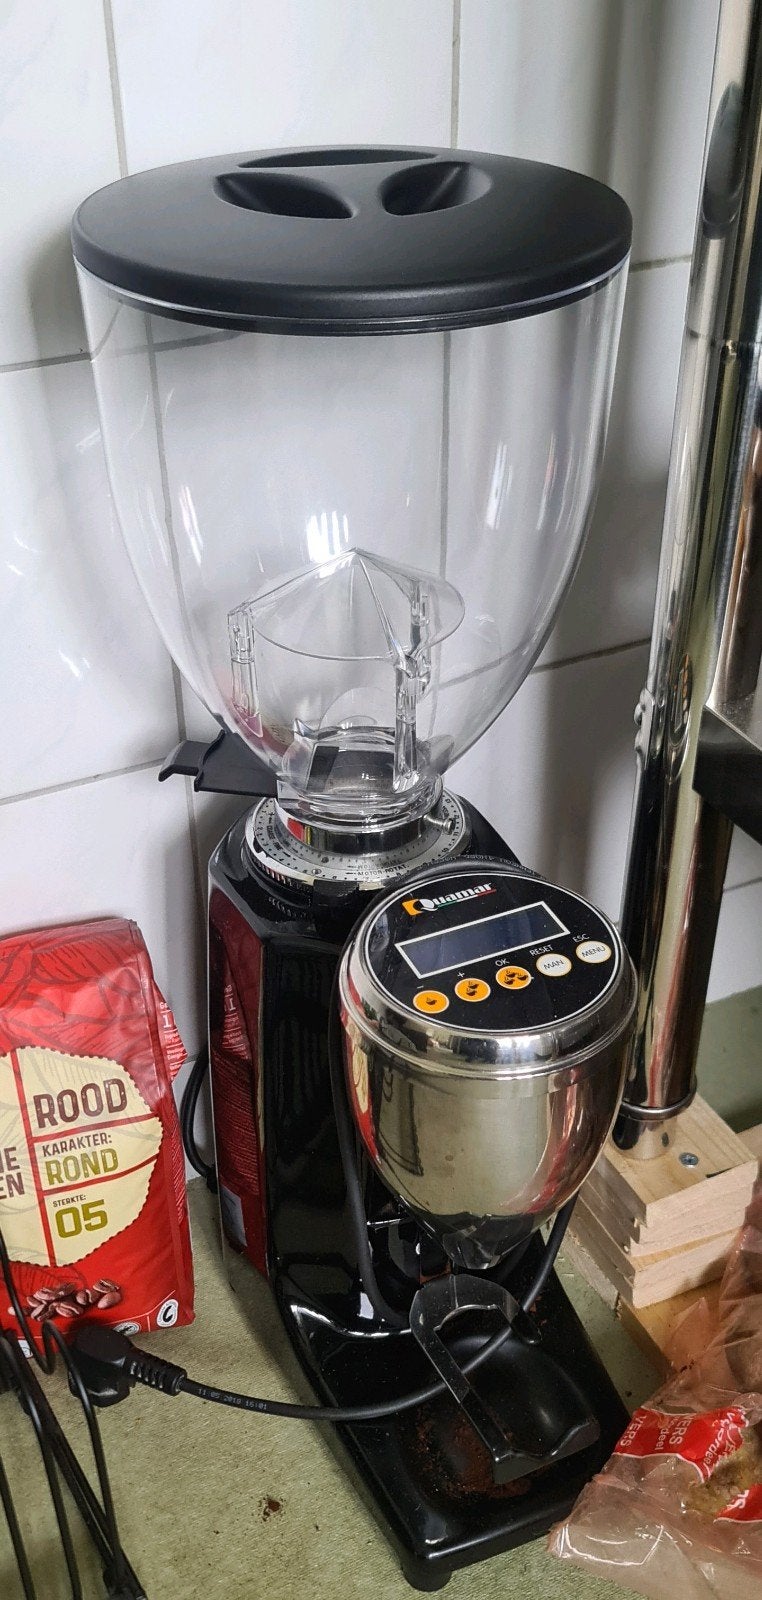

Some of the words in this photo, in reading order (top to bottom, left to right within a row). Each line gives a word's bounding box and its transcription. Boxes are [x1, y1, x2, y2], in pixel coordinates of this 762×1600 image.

[416, 883, 492, 911] Quamar
[572, 933, 590, 943] ESC
[529, 944, 554, 956] RESET
[581, 945, 606, 958] MENU
[495, 958, 510, 967] OK
[543, 959, 565, 971] MAN
[33, 1078, 128, 1129] ROOD
[42, 1132, 112, 1158] KARAKTER:
[45, 1148, 119, 1186] ROND
[53, 1194, 87, 1208] STERKTE:
[55, 1199, 109, 1239] 05
[619, 1415, 647, 1447] VERS
